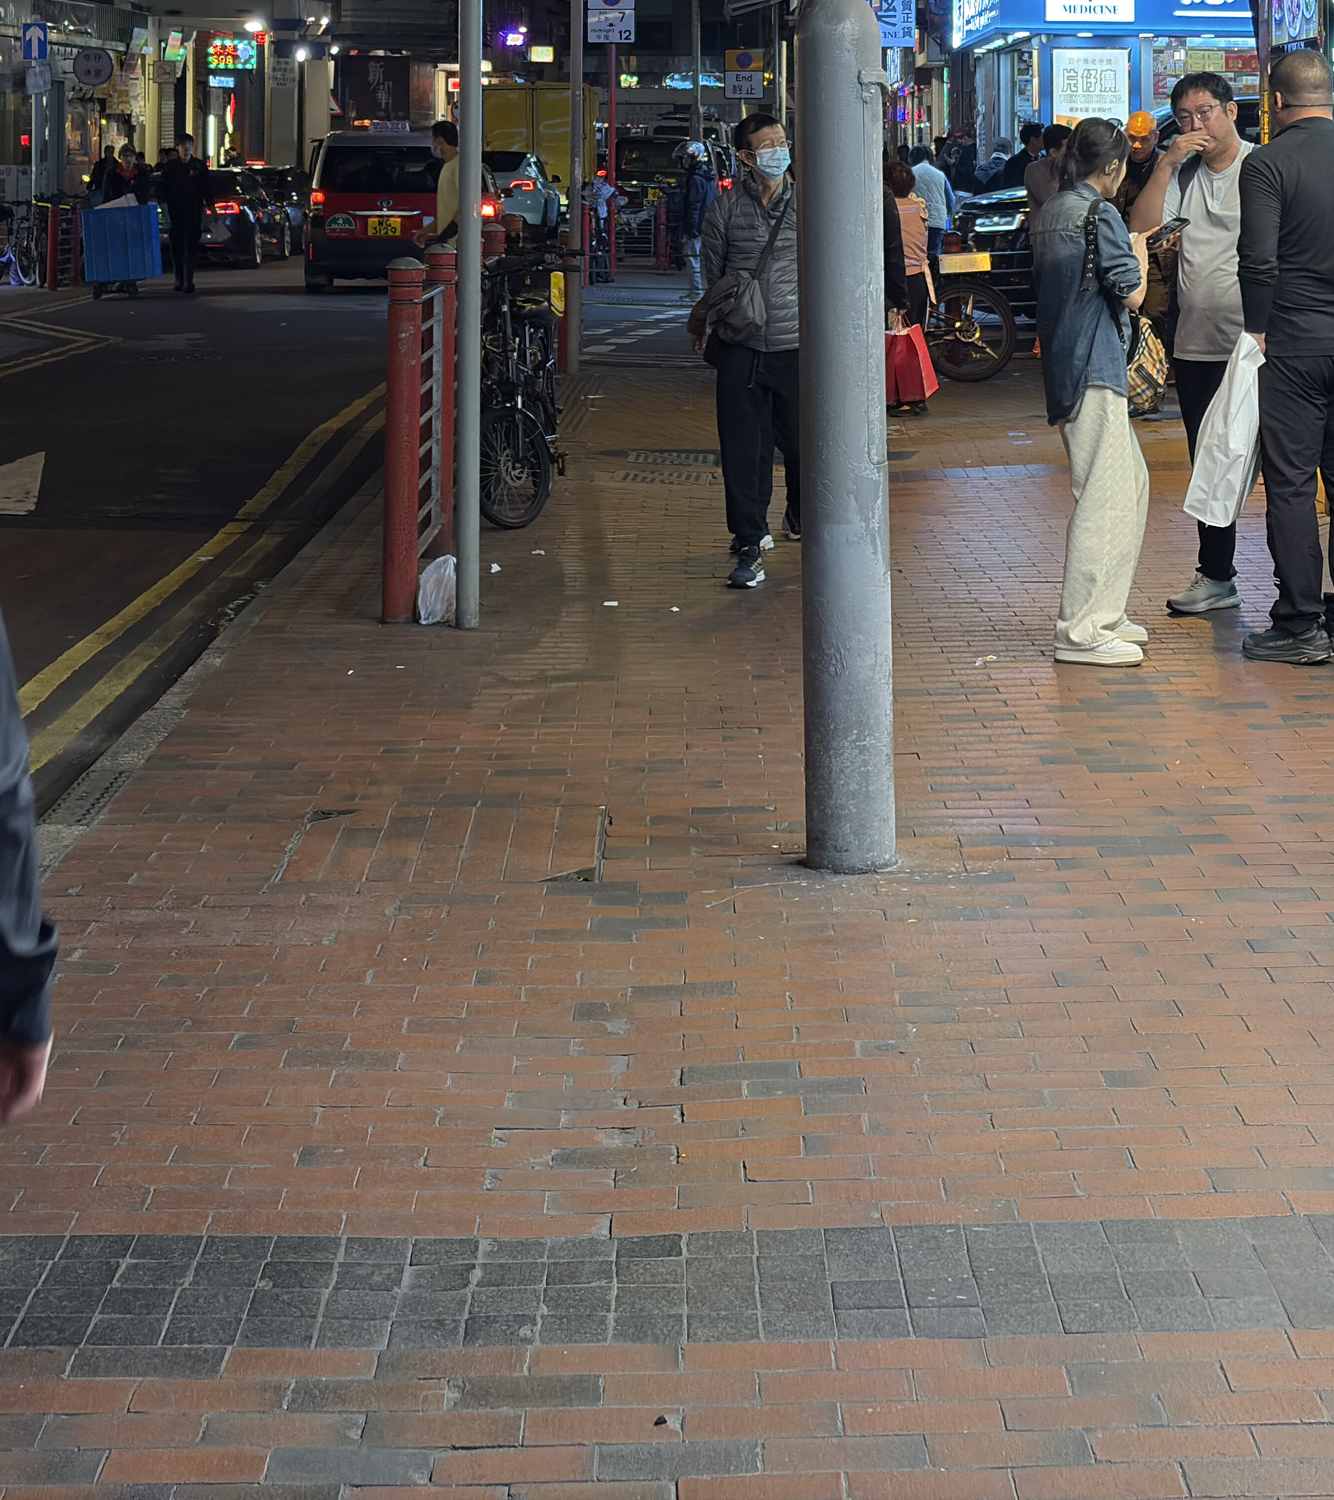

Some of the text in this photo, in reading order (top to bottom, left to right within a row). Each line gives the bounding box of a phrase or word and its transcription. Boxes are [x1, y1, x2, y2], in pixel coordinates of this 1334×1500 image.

[1062, 4, 1119, 15] MEDICINE
[618, 12, 626, 23] 7
[618, 30, 632, 41] 12
[736, 74, 753, 82] End
[1061, 68, 1117, 93] 片仔癀
[732, 83, 756, 96] 終止
[372, 122, 409, 131] TAXI
[377, 219, 392, 227] WG
[371, 226, 397, 235] 3129
